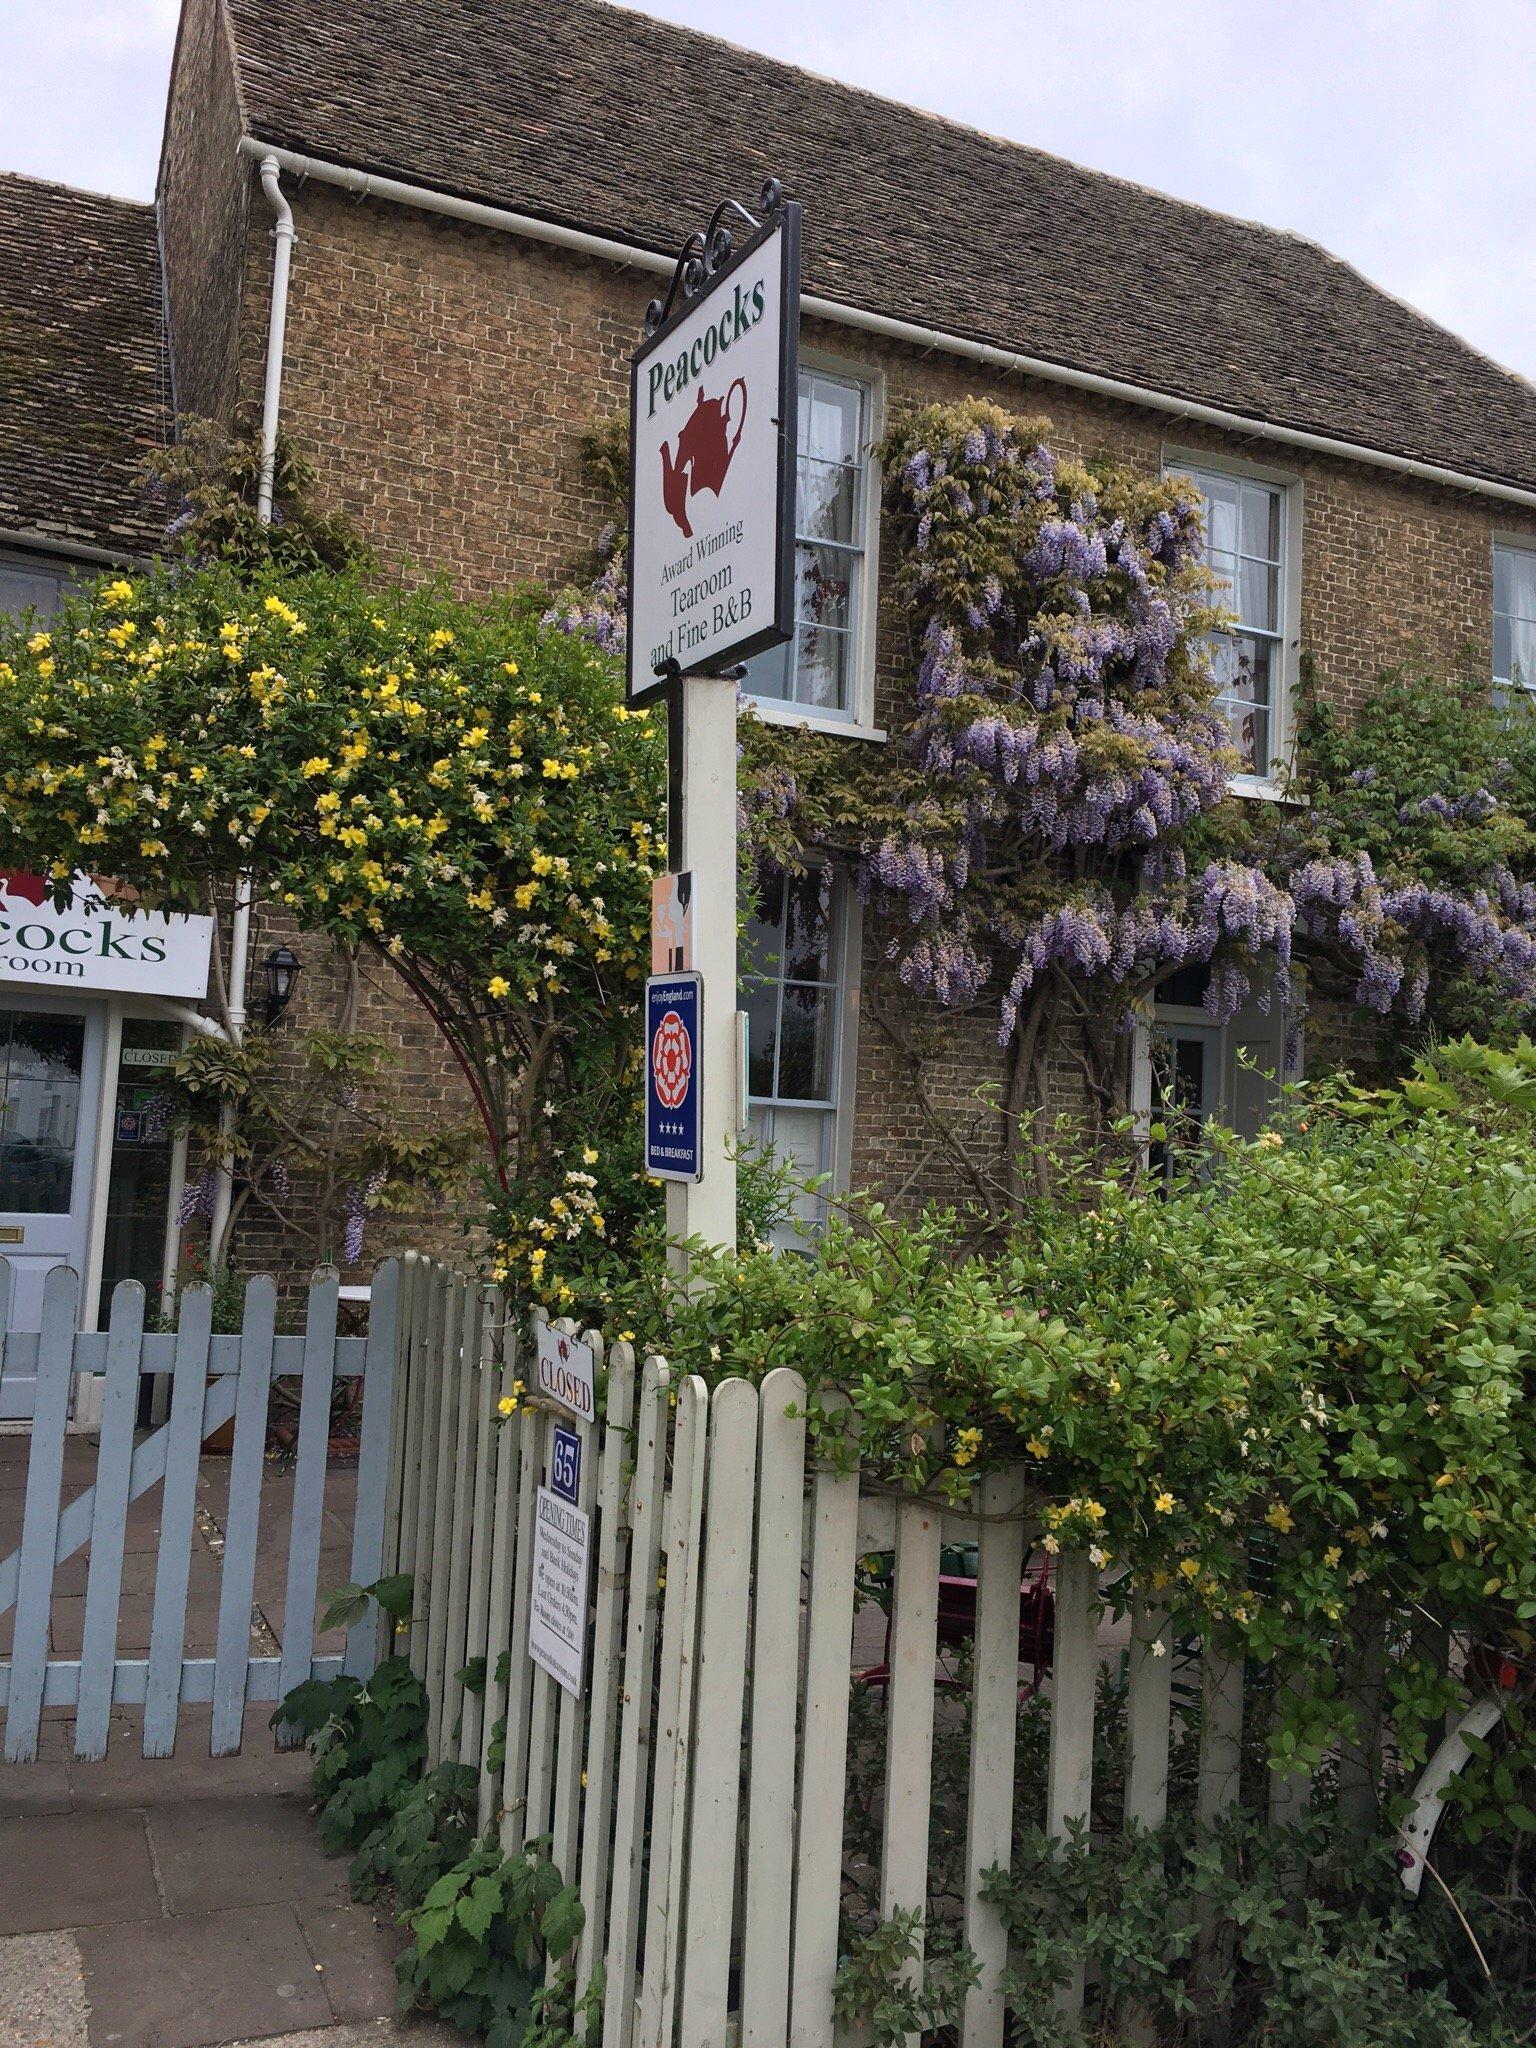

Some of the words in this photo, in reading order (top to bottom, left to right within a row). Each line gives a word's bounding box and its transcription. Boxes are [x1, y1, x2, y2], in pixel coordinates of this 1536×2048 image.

[646, 277, 765, 421] Peacocks
[661, 546, 693, 586] Award
[696, 520, 744, 562] Winning
[670, 564, 733, 617] Tearoom
[651, 630, 674, 668] and
[677, 620, 708, 654] Fine
[712, 588, 752, 636] B&B
[651, 989, 694, 1004] enjoyEngland.com
[650, 1145, 660, 1156] BED
[660, 1147, 665, 1157] &
[665, 1147, 694, 1160] BREAKFAST
[541, 1356, 591, 1414] CLOSED
[554, 1440, 574, 1488] 65
[539, 1495, 564, 1529] OPENING
[565, 1511, 585, 1543] TIMES
[539, 1526, 560, 1553] Wednesday
[561, 1542, 566, 1554] to
[566, 1545, 582, 1568] Sunday
[541, 1544, 549, 1560] and
[549, 1550, 560, 1568] Bank
[561, 1559, 578, 1583] Holidays
[538, 1583, 546, 1600] Last
